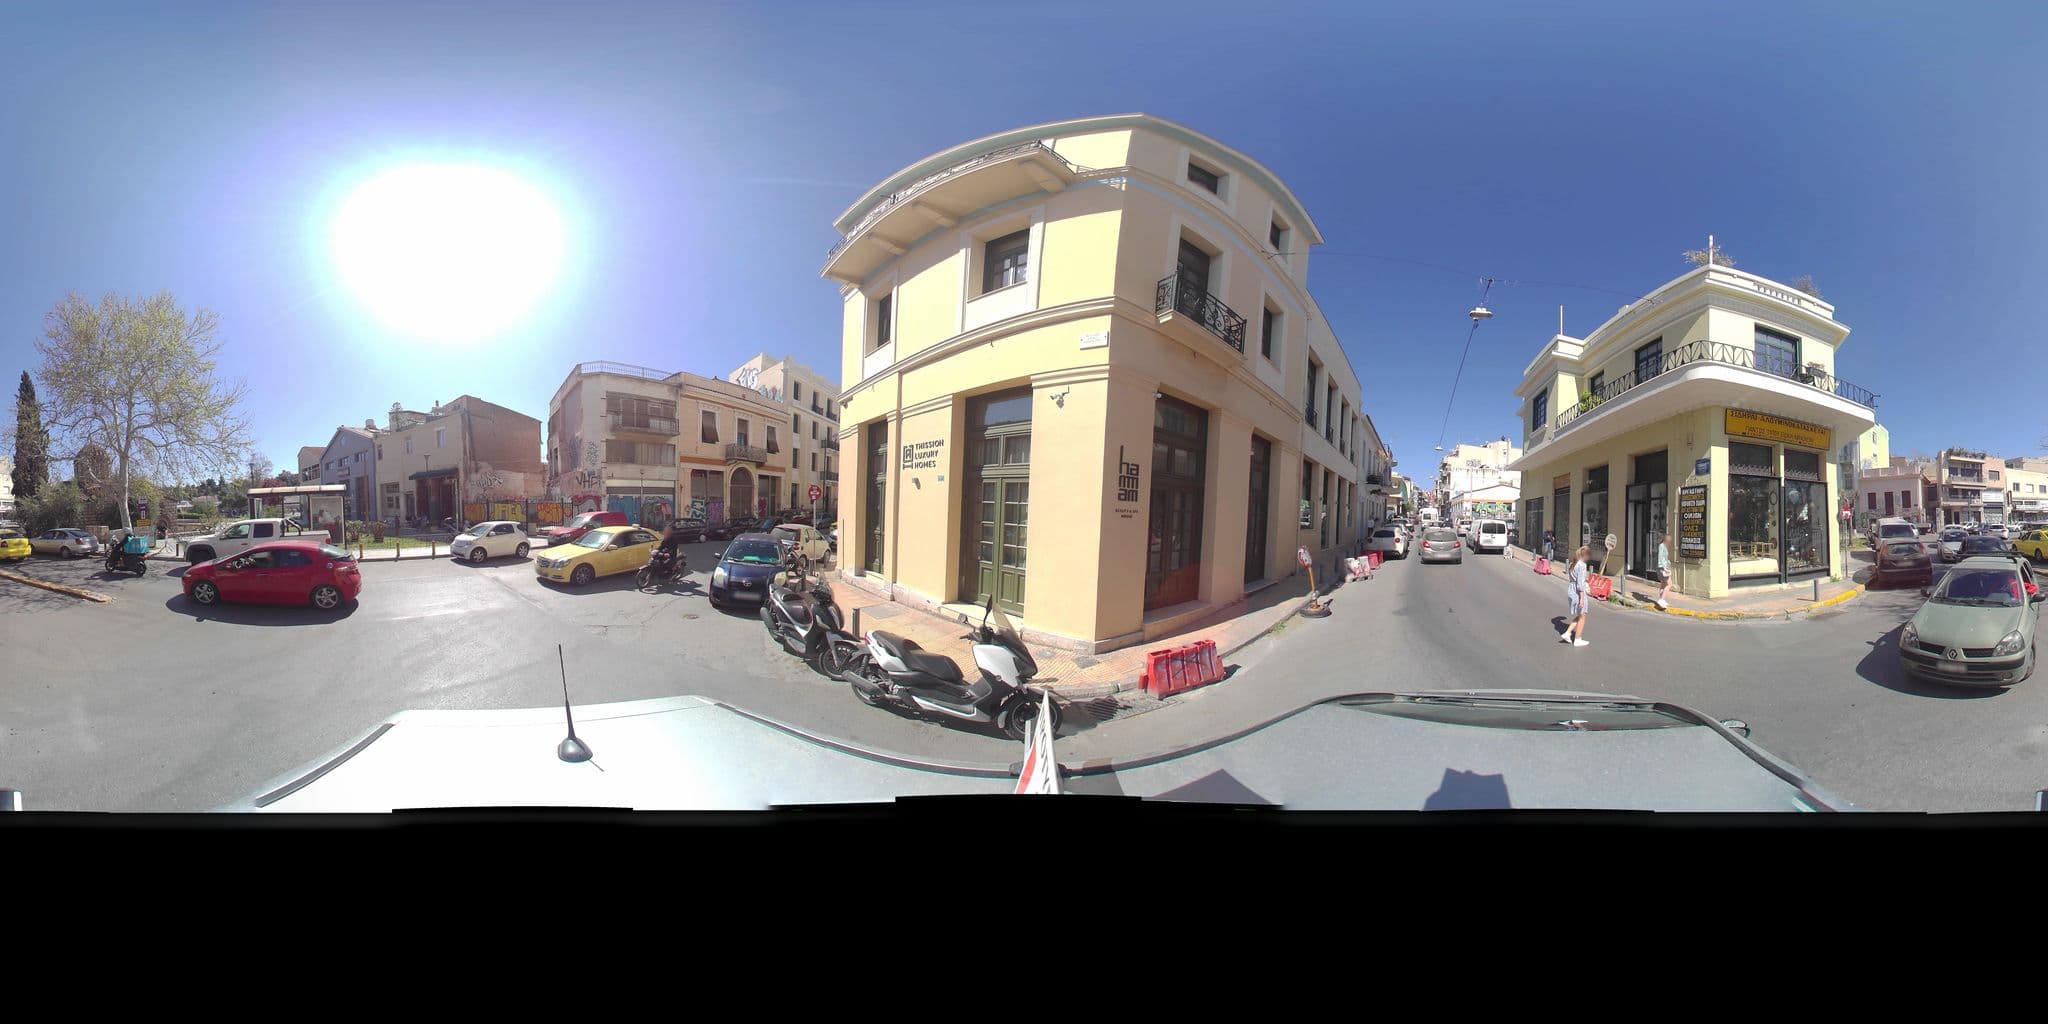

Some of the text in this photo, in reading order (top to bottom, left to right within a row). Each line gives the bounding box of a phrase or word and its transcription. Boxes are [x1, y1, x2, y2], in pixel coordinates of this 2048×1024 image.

[915, 439, 944, 450] THISSION
[914, 450, 938, 459] LUXURY
[914, 460, 936, 469] HOMES
